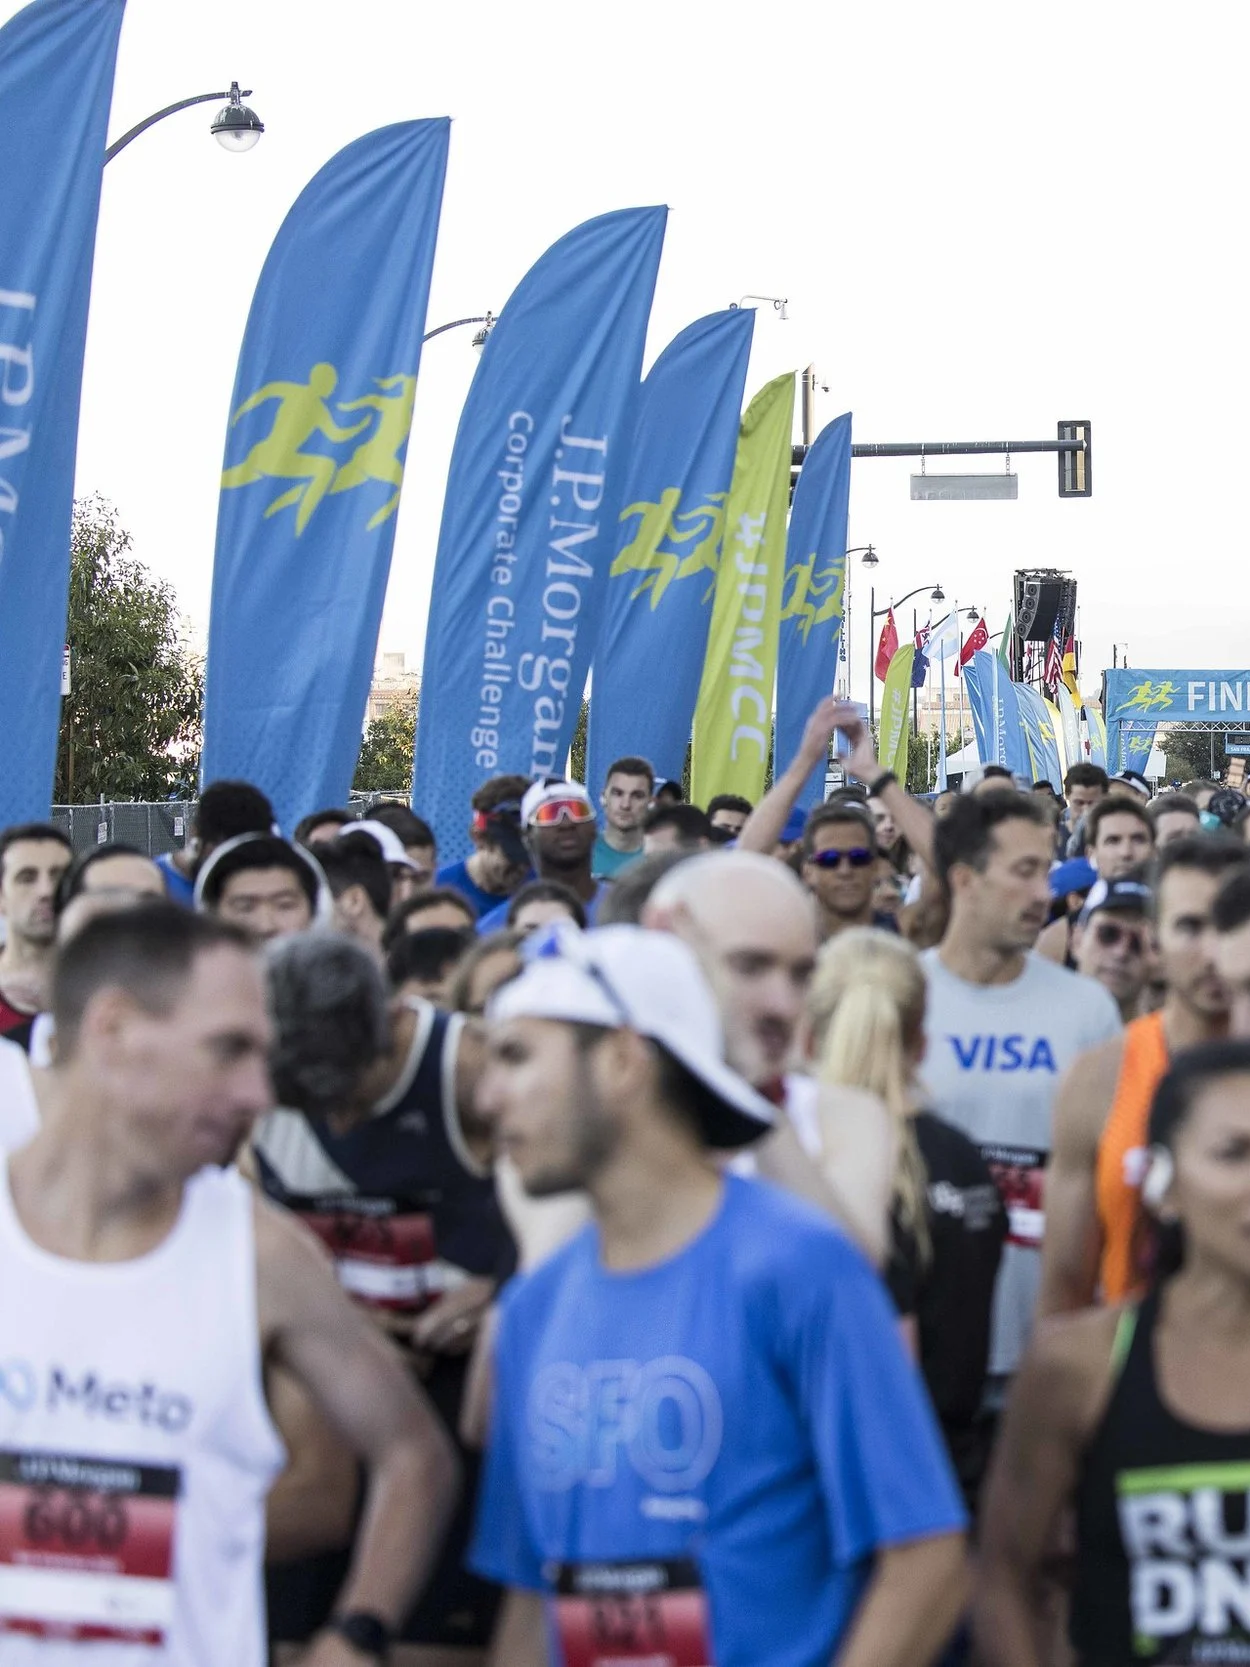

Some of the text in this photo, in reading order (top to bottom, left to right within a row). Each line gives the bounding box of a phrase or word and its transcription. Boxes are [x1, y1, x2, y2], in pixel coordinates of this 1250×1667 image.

[470, 410, 534, 770] Corporate Challenge
[517, 413, 608, 780] J.P.Morgan
[950, 1034, 1058, 1075] VISA
[521, 1353, 724, 1494] SFO
